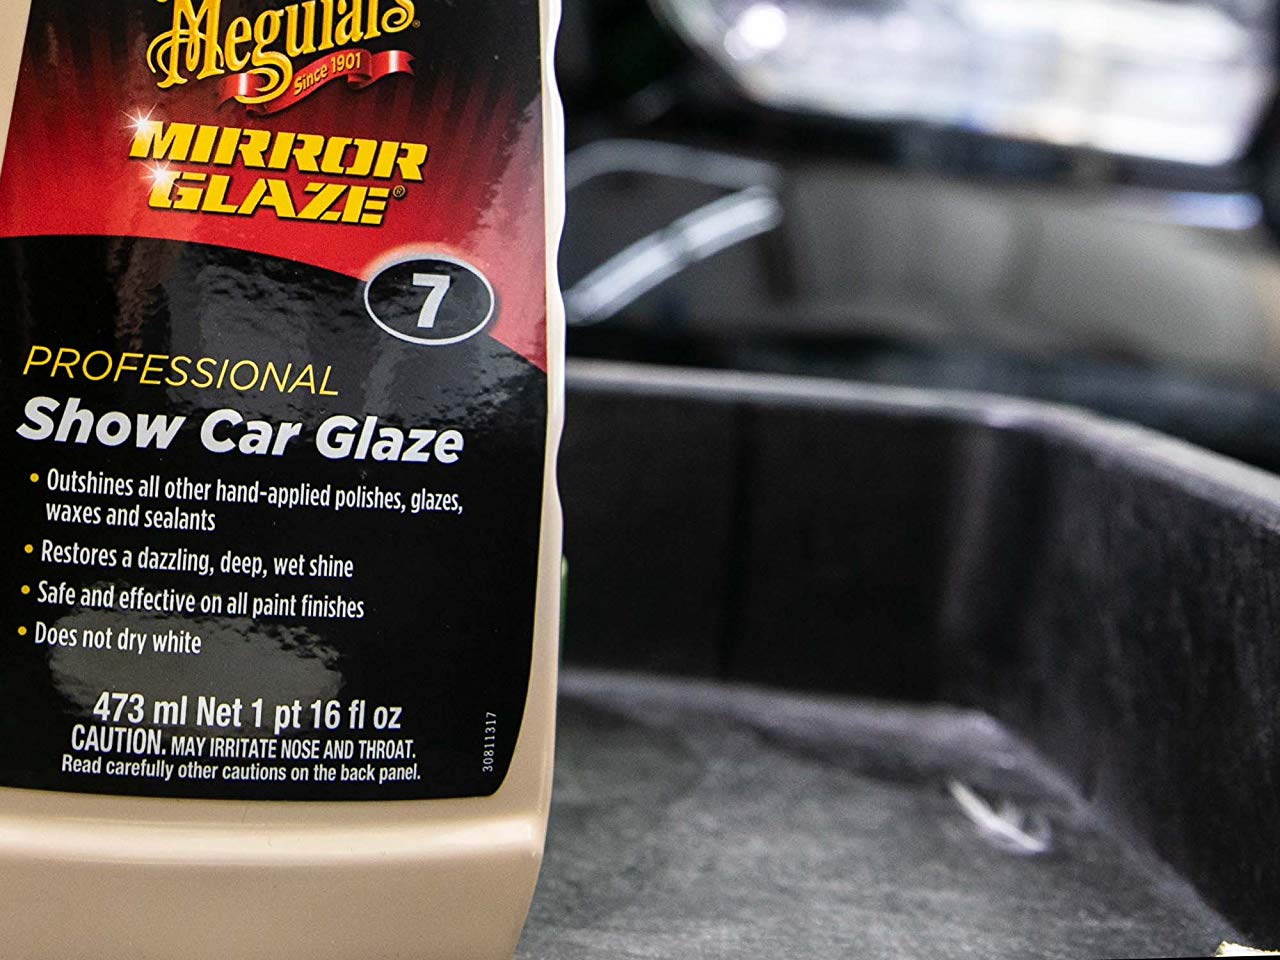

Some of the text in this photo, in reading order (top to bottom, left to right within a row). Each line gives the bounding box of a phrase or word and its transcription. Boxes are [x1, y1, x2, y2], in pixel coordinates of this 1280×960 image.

[292, 51, 361, 96] Since 1901
[129, 120, 428, 181] MIRROR
[412, 273, 451, 329] 7
[23, 345, 339, 396] PROFESSIONAL
[15, 396, 464, 464] Show Car Glaze
[47, 468, 463, 515] Outshines all other hand-applied polishes, glazes,
[45, 502, 216, 531] waxes and sealants
[41, 539, 354, 579] Restores a dazzling, deep, wet shine
[37, 580, 365, 619] Safe and effective on all paint finishes
[34, 621, 202, 655] Does not dry white
[92, 691, 402, 736] 473 ml Net 1 pt 16 fl oz
[71, 723, 416, 760] CAUTION. MAY IRRITATE NOSE AND THROAT.
[482, 712, 496, 772] 30811317
[61, 753, 421, 785] Read carefully other cautions on the back panel.
